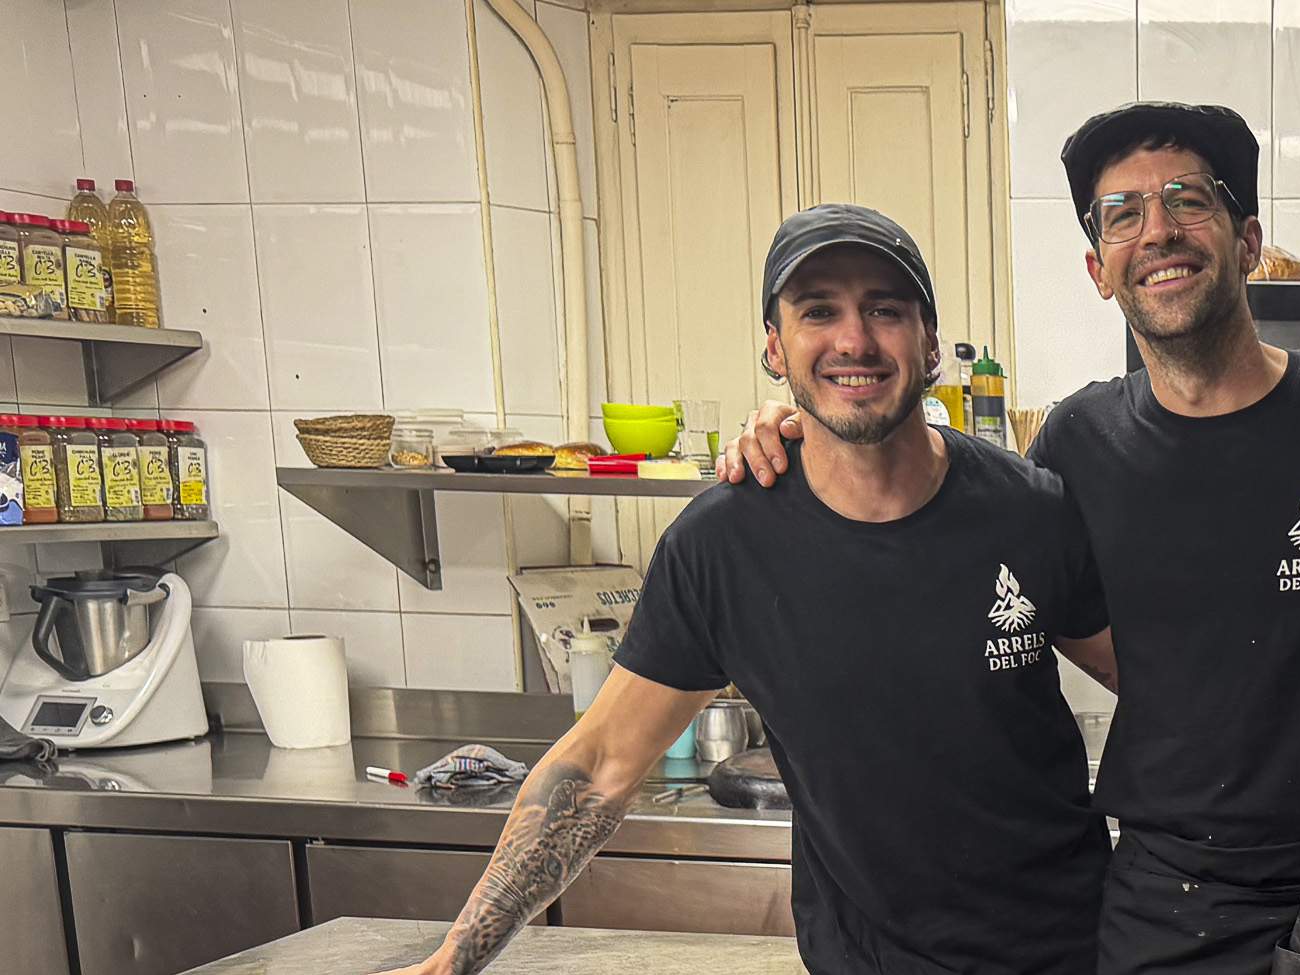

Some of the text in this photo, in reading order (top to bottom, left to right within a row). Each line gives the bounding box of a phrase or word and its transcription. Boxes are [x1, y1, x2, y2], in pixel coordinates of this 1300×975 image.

[985, 632, 1045, 656] ARRELS
[989, 650, 1041, 671] DEL FOC
